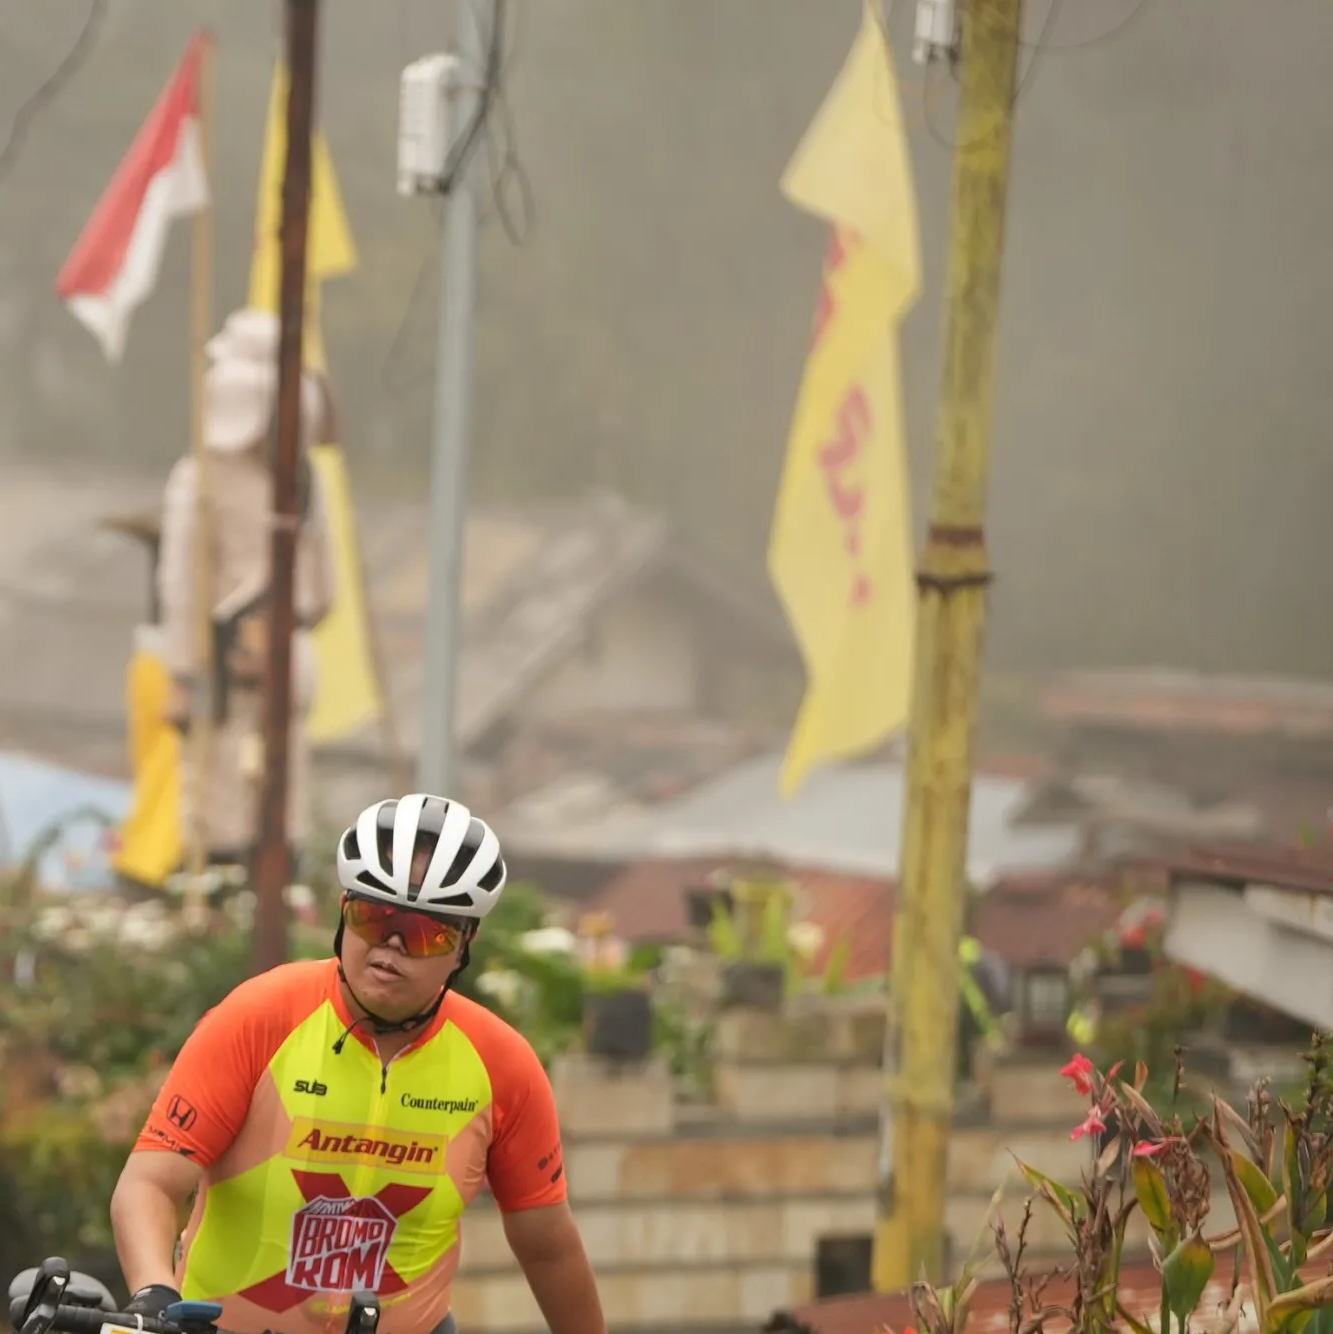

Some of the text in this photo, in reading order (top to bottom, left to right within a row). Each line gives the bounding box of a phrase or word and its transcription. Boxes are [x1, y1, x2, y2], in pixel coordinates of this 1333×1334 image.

[400, 1092, 476, 1114] Counterpain
[297, 1128, 434, 1165] Antangin
[299, 1217, 384, 1258] BROMO
[292, 1241, 381, 1290] KOM
